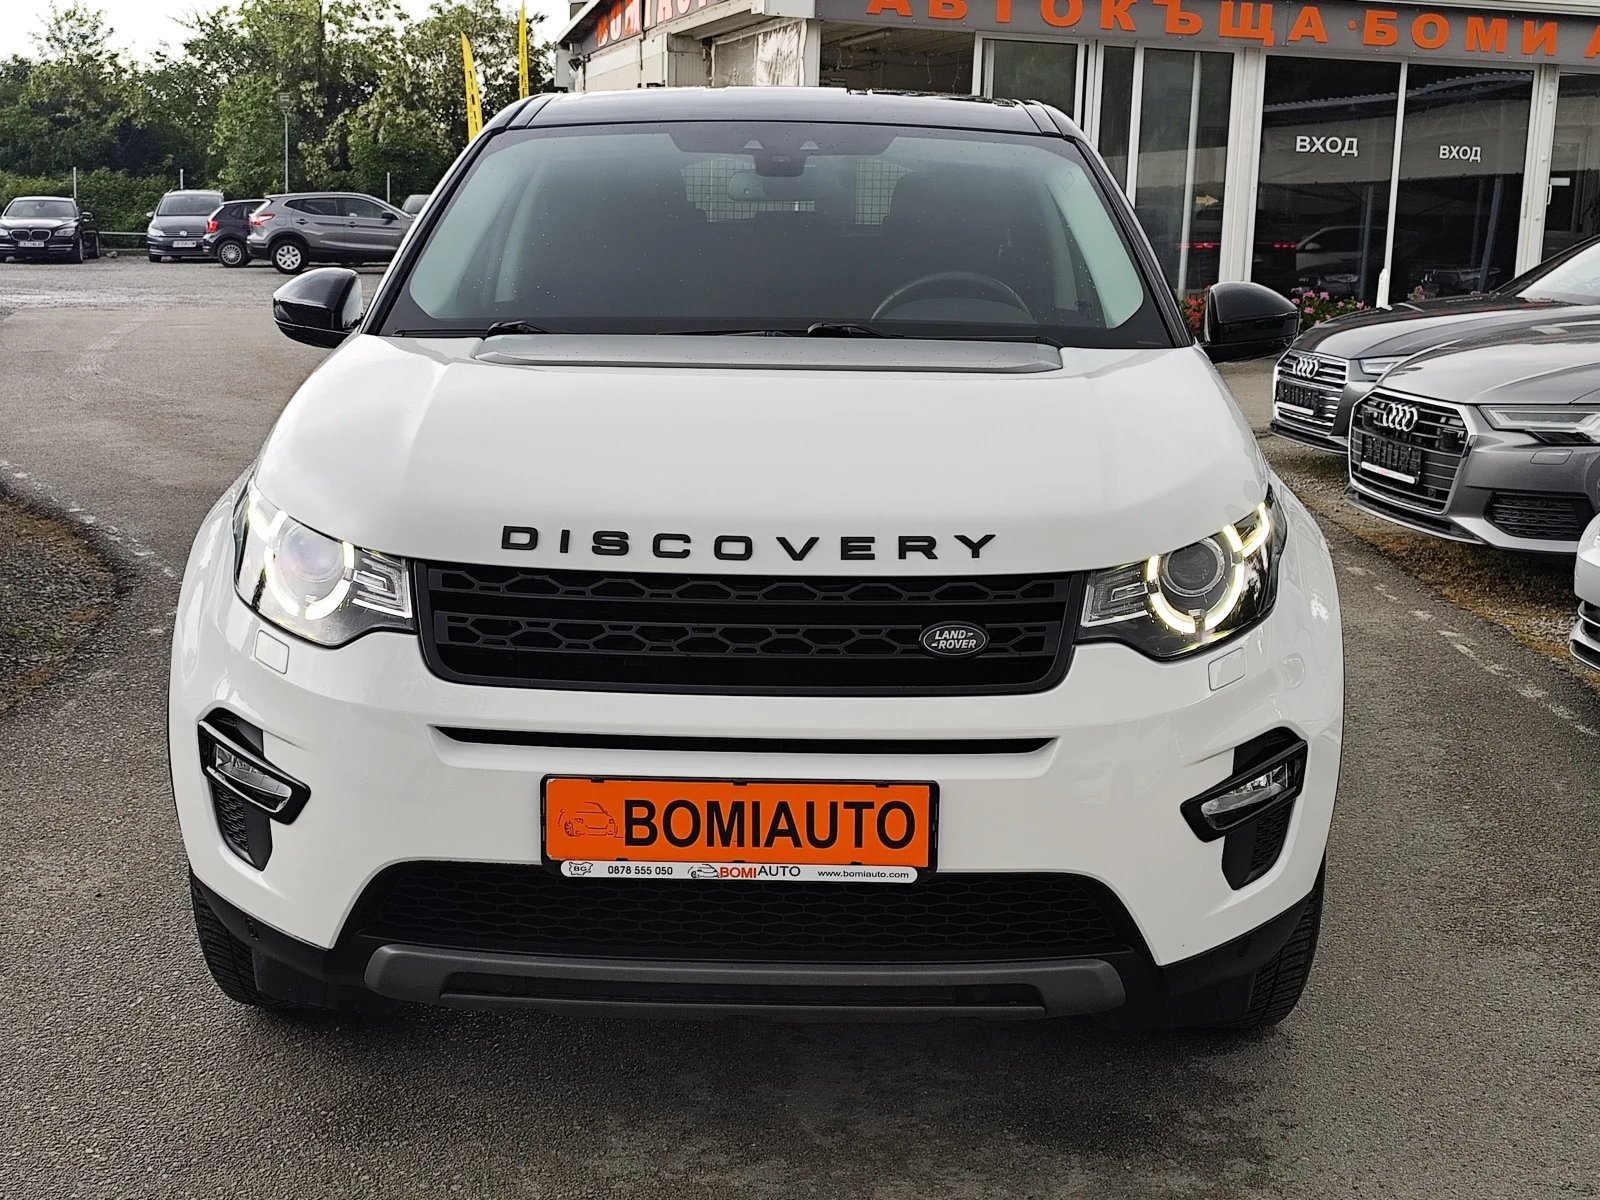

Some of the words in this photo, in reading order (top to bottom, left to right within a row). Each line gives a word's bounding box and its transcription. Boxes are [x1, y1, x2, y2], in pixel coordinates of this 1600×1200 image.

[596, 0, 707, 47] BOMI
[1362, 9, 1558, 56] БОМИ
[1295, 135, 1359, 157] ВХОД
[1438, 145, 1482, 162] ВХОД
[501, 525, 996, 561] DISCOVERY
[935, 630, 967, 640] LAND
[938, 639, 977, 649] ROVER
[623, 799, 916, 850] BOMIAUTO
[607, 865, 632, 875] 0878
[634, 866, 652, 875] 555
[655, 866, 673, 875] 050
[719, 865, 801, 879] BOMIAUTO
[817, 869, 910, 879] www.bomiauto.com
